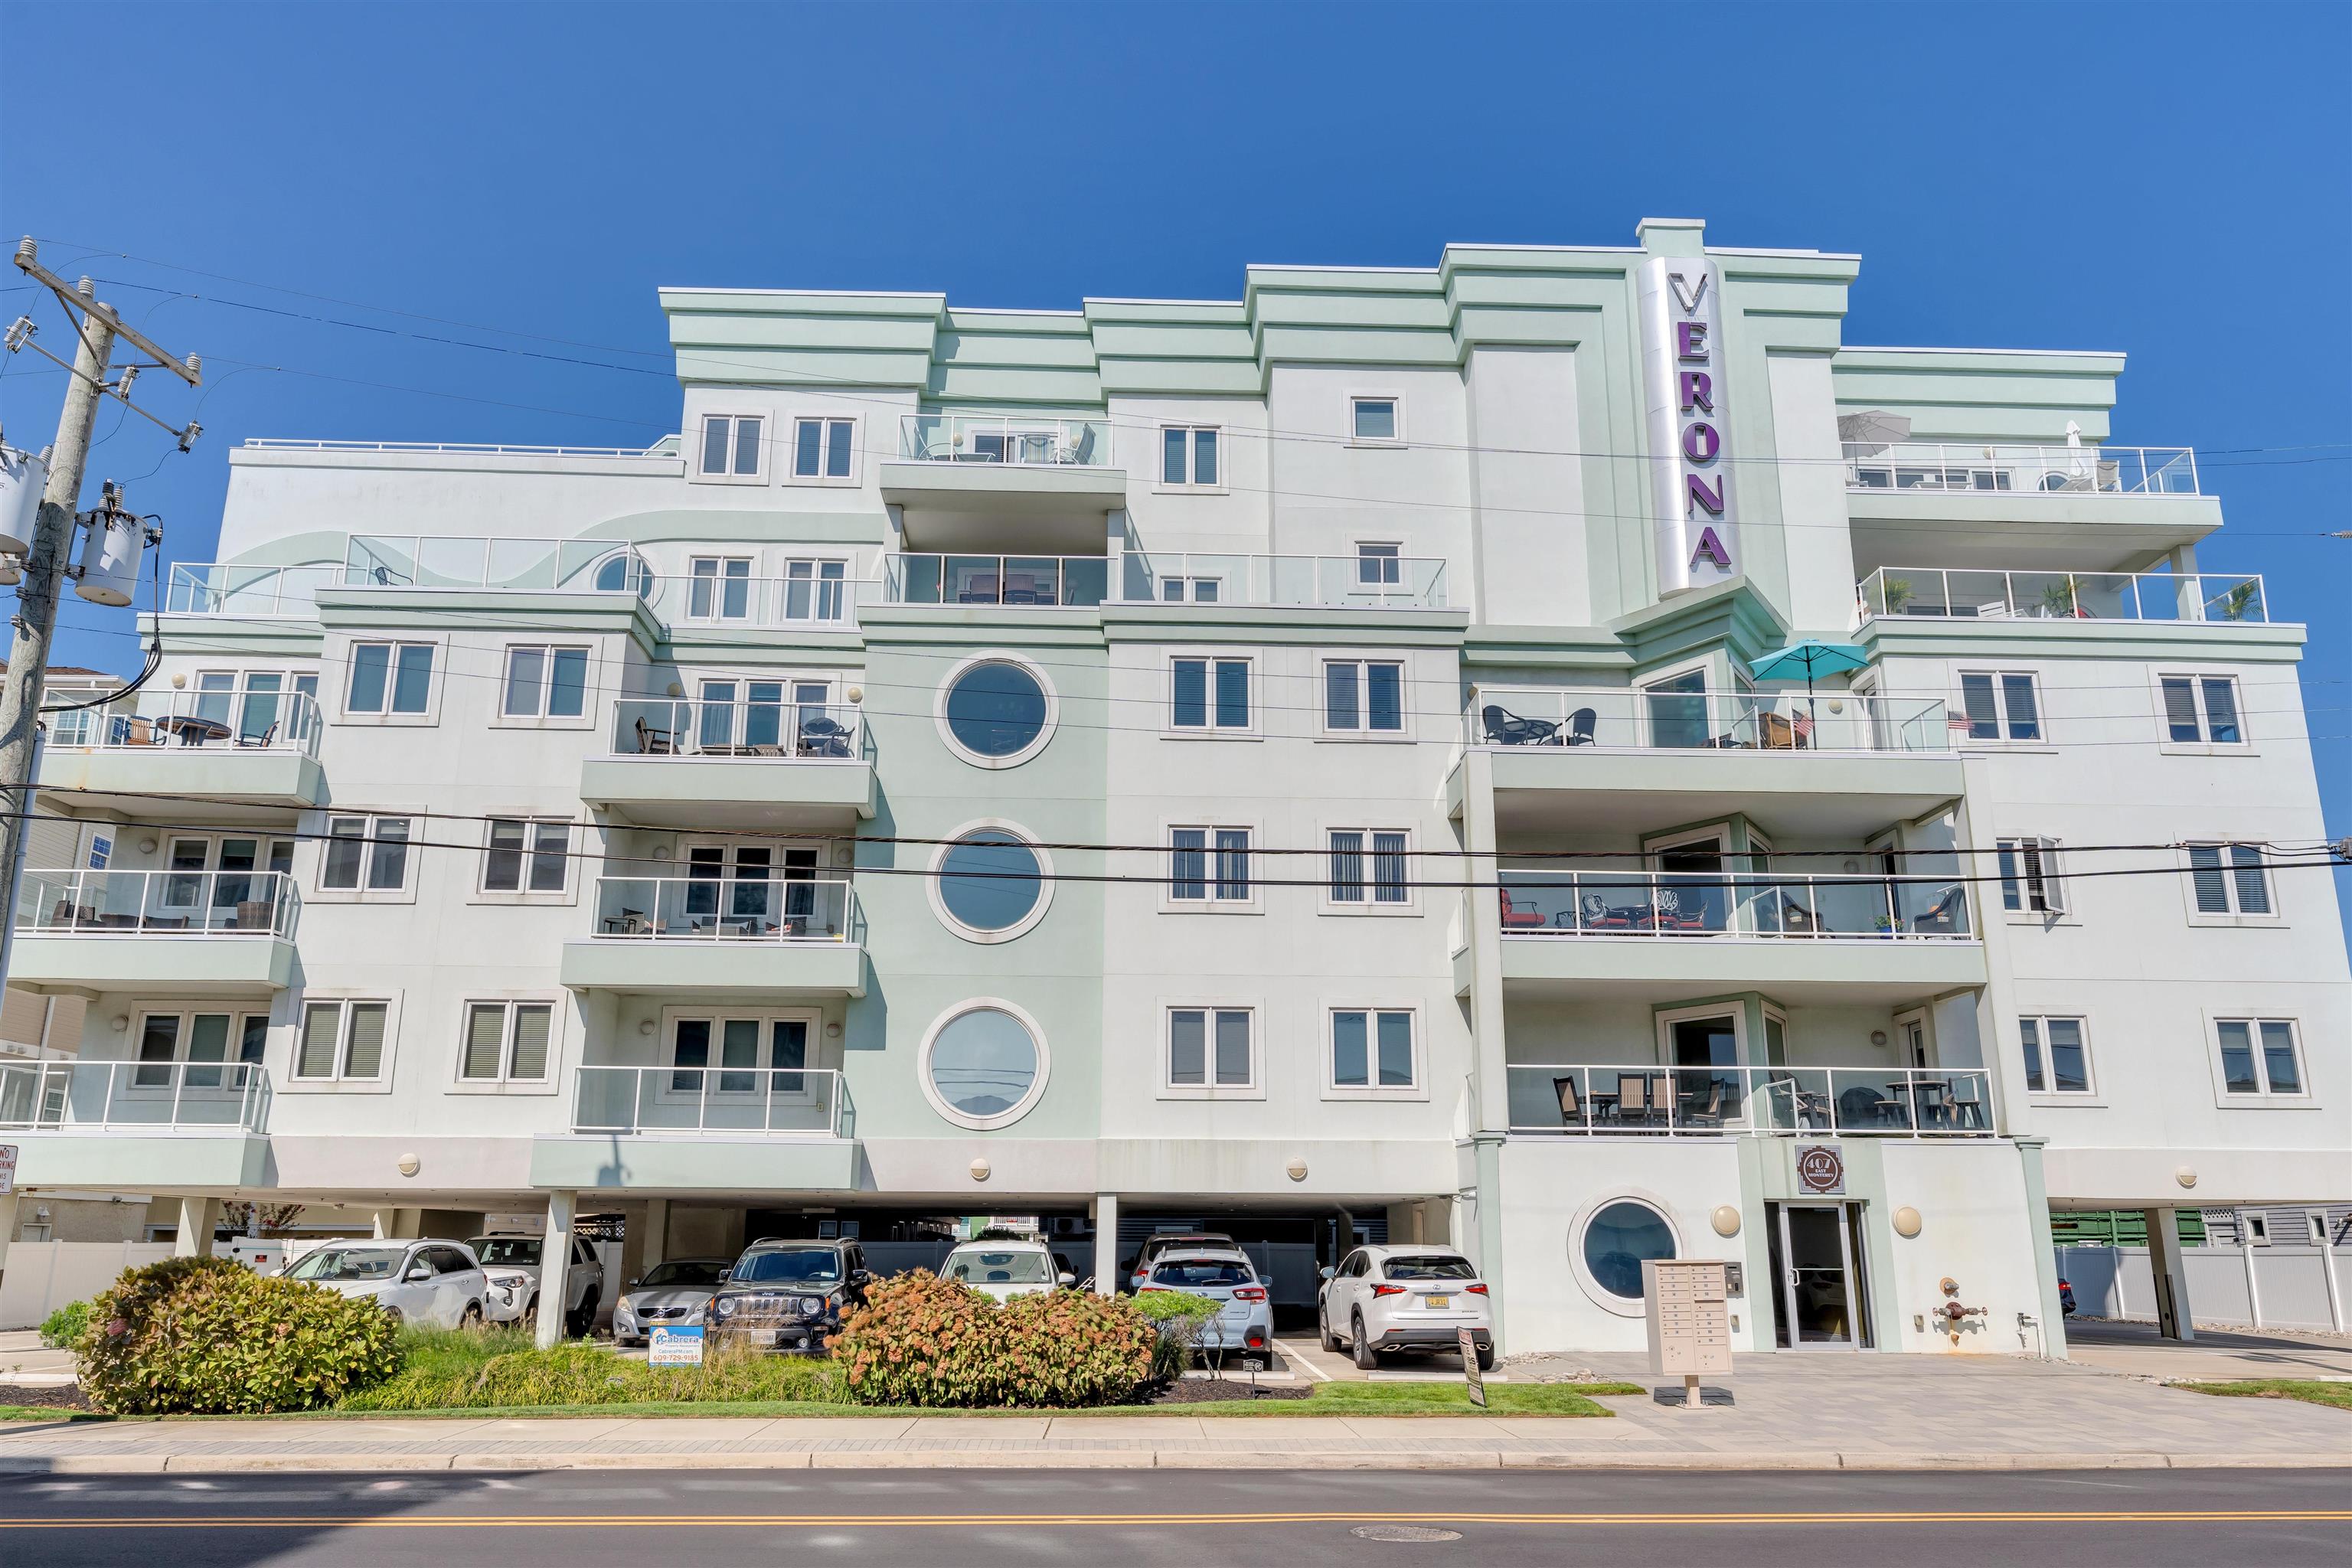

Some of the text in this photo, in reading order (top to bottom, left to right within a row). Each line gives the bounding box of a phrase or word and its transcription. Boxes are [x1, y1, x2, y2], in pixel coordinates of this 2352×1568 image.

[1667, 272, 1732, 566] VERONA
[0, 1150, 9, 1158] NO
[1807, 1158, 1831, 1168] 407
